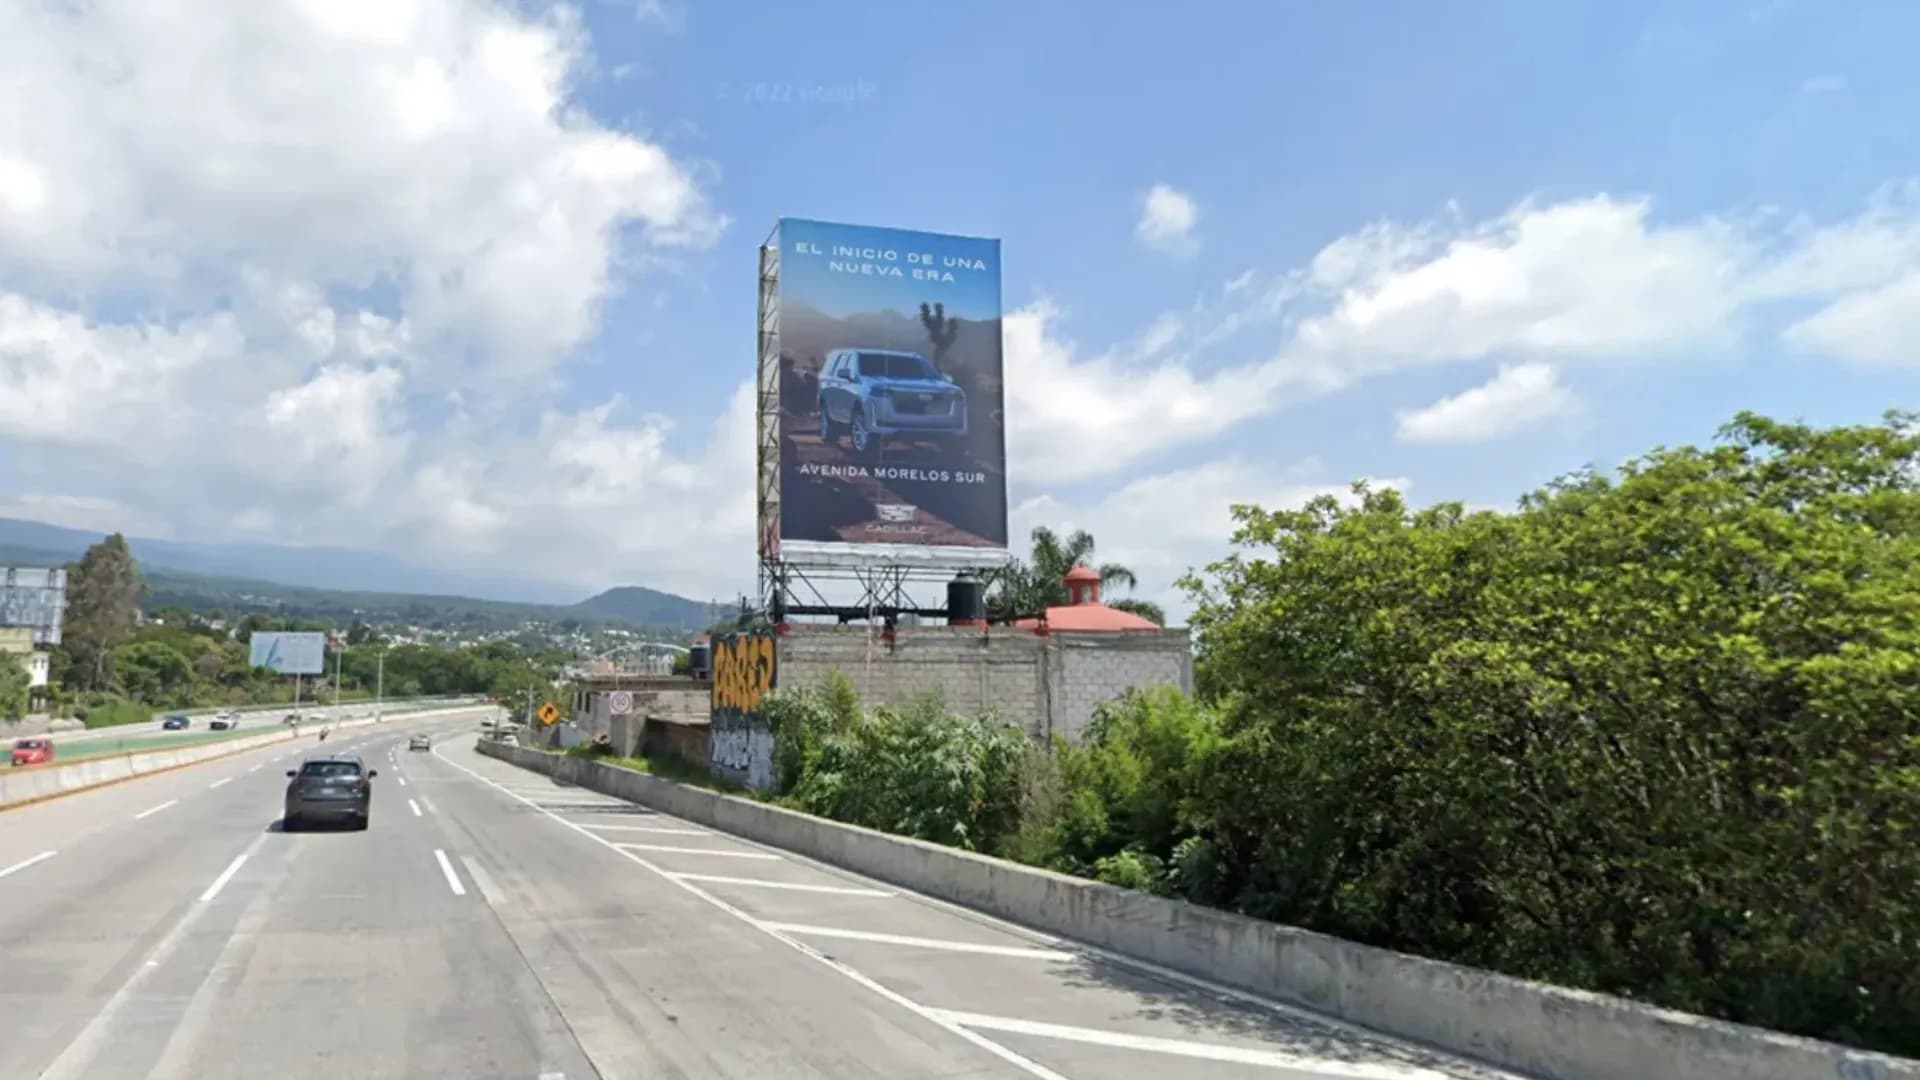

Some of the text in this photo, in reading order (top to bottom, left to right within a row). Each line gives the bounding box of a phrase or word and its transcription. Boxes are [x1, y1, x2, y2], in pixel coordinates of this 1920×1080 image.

[796, 242, 986, 271] EL INICIO DE UNA
[830, 261, 955, 283] NUEVA ERA
[800, 463, 985, 484] AVENIDA MORELOS SUR
[864, 523, 928, 535] CADILLAC
